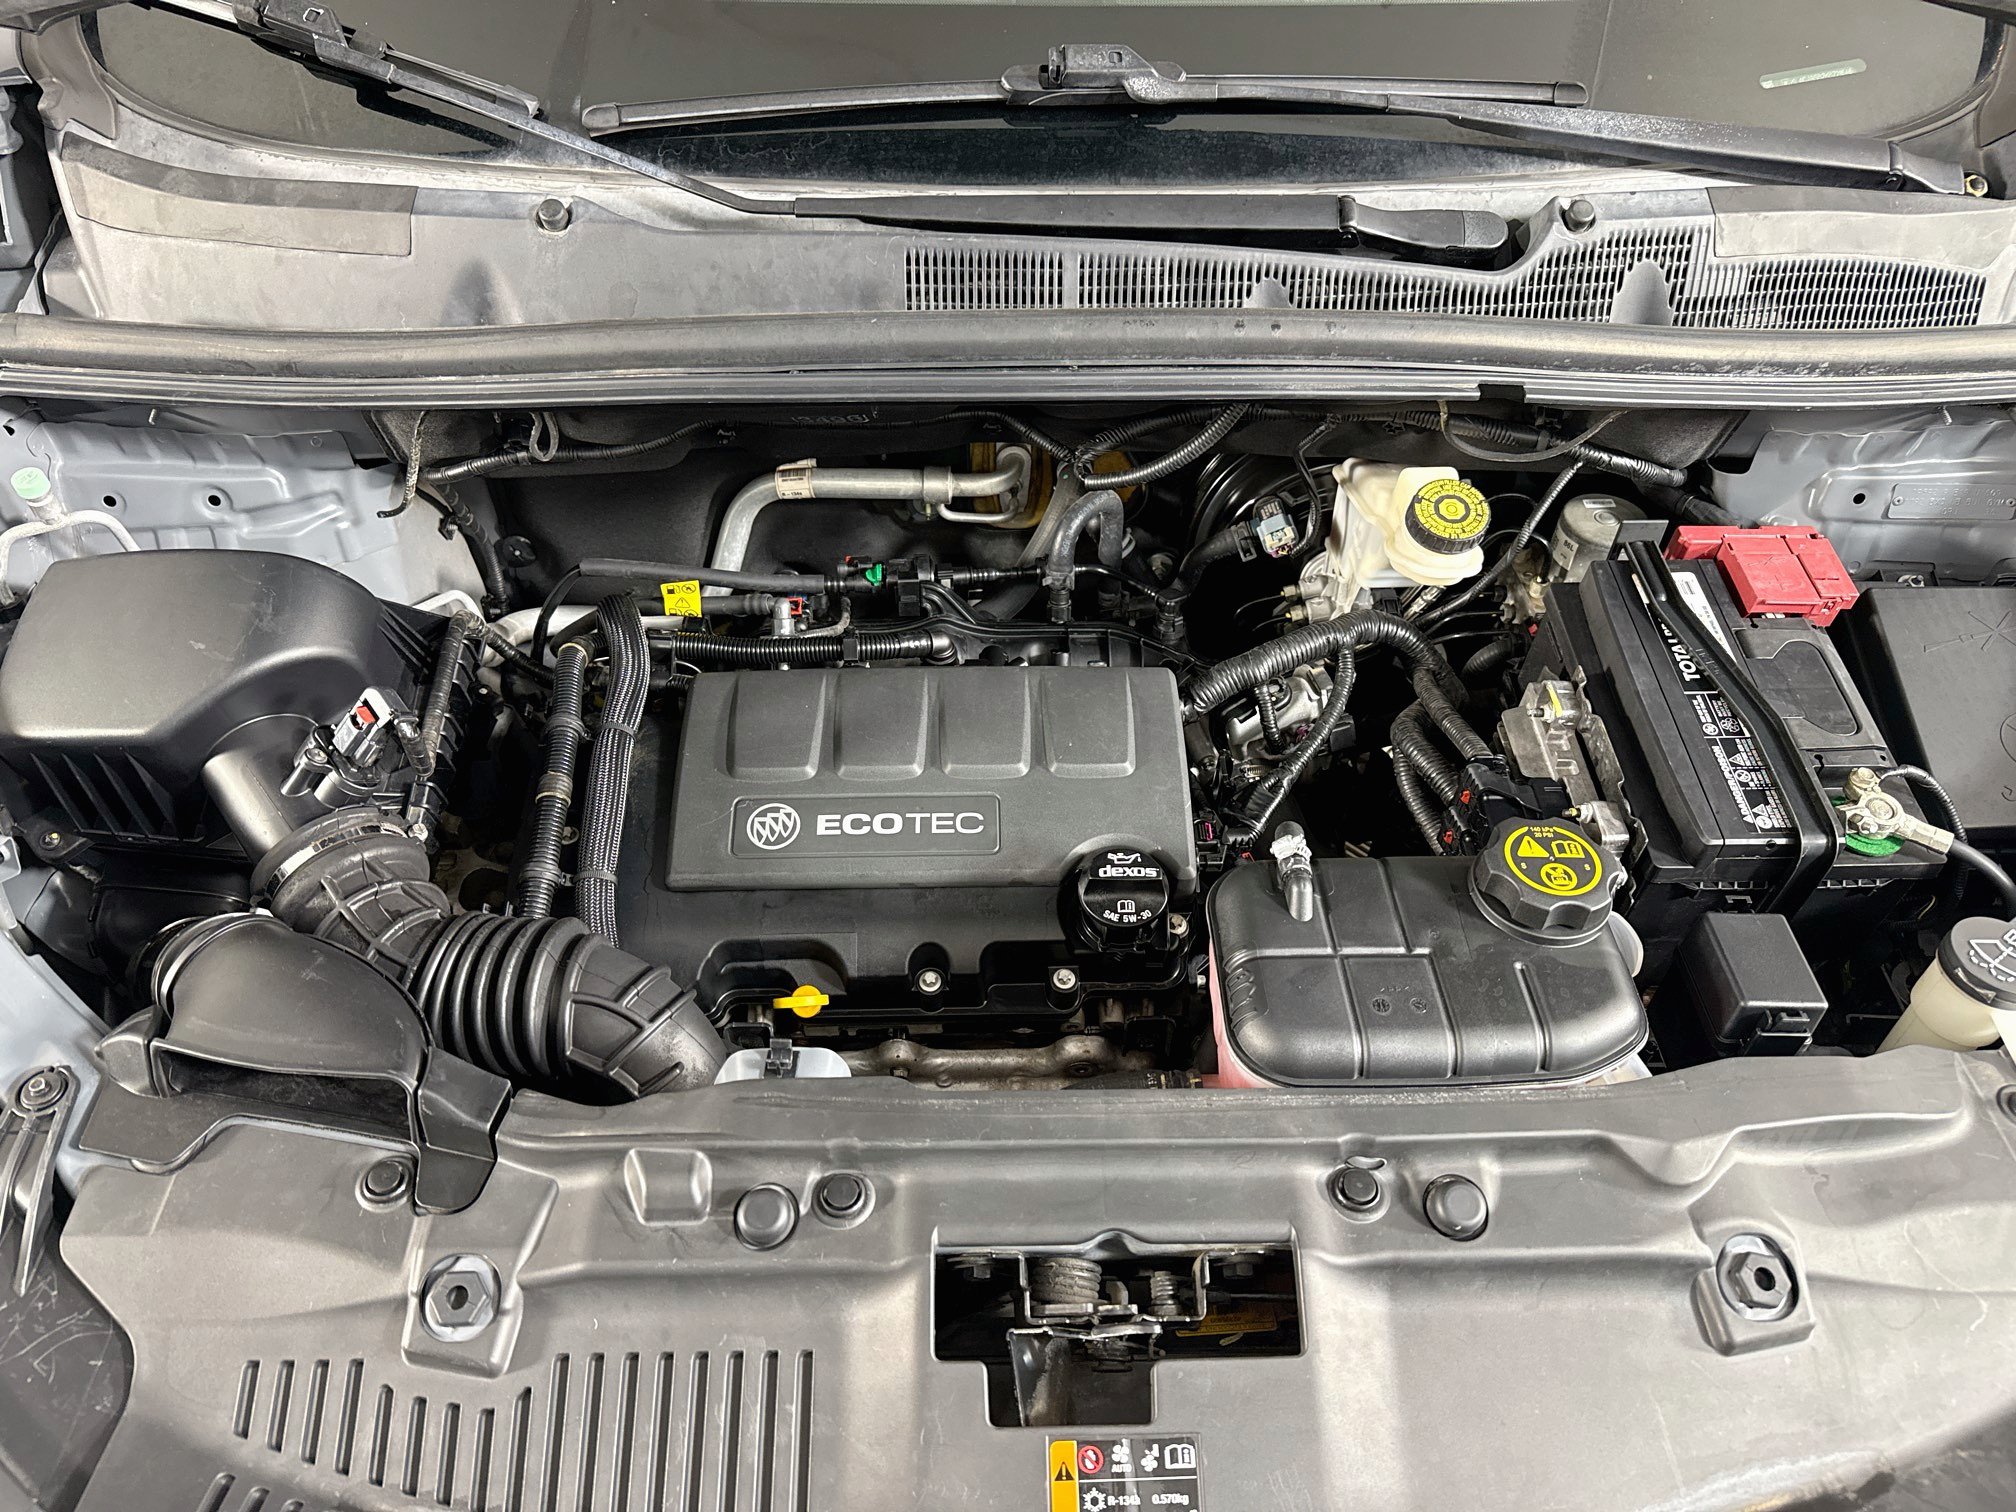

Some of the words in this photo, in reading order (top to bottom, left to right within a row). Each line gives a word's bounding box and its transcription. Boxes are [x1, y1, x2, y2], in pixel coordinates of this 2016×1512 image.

[816, 812, 985, 836] ECOTEC
[1098, 864, 1158, 877] dexos
[1103, 910, 1120, 922] SAE
[1123, 909, 1152, 923] 5W-30
[1111, 1463, 1132, 1473] AUTO
